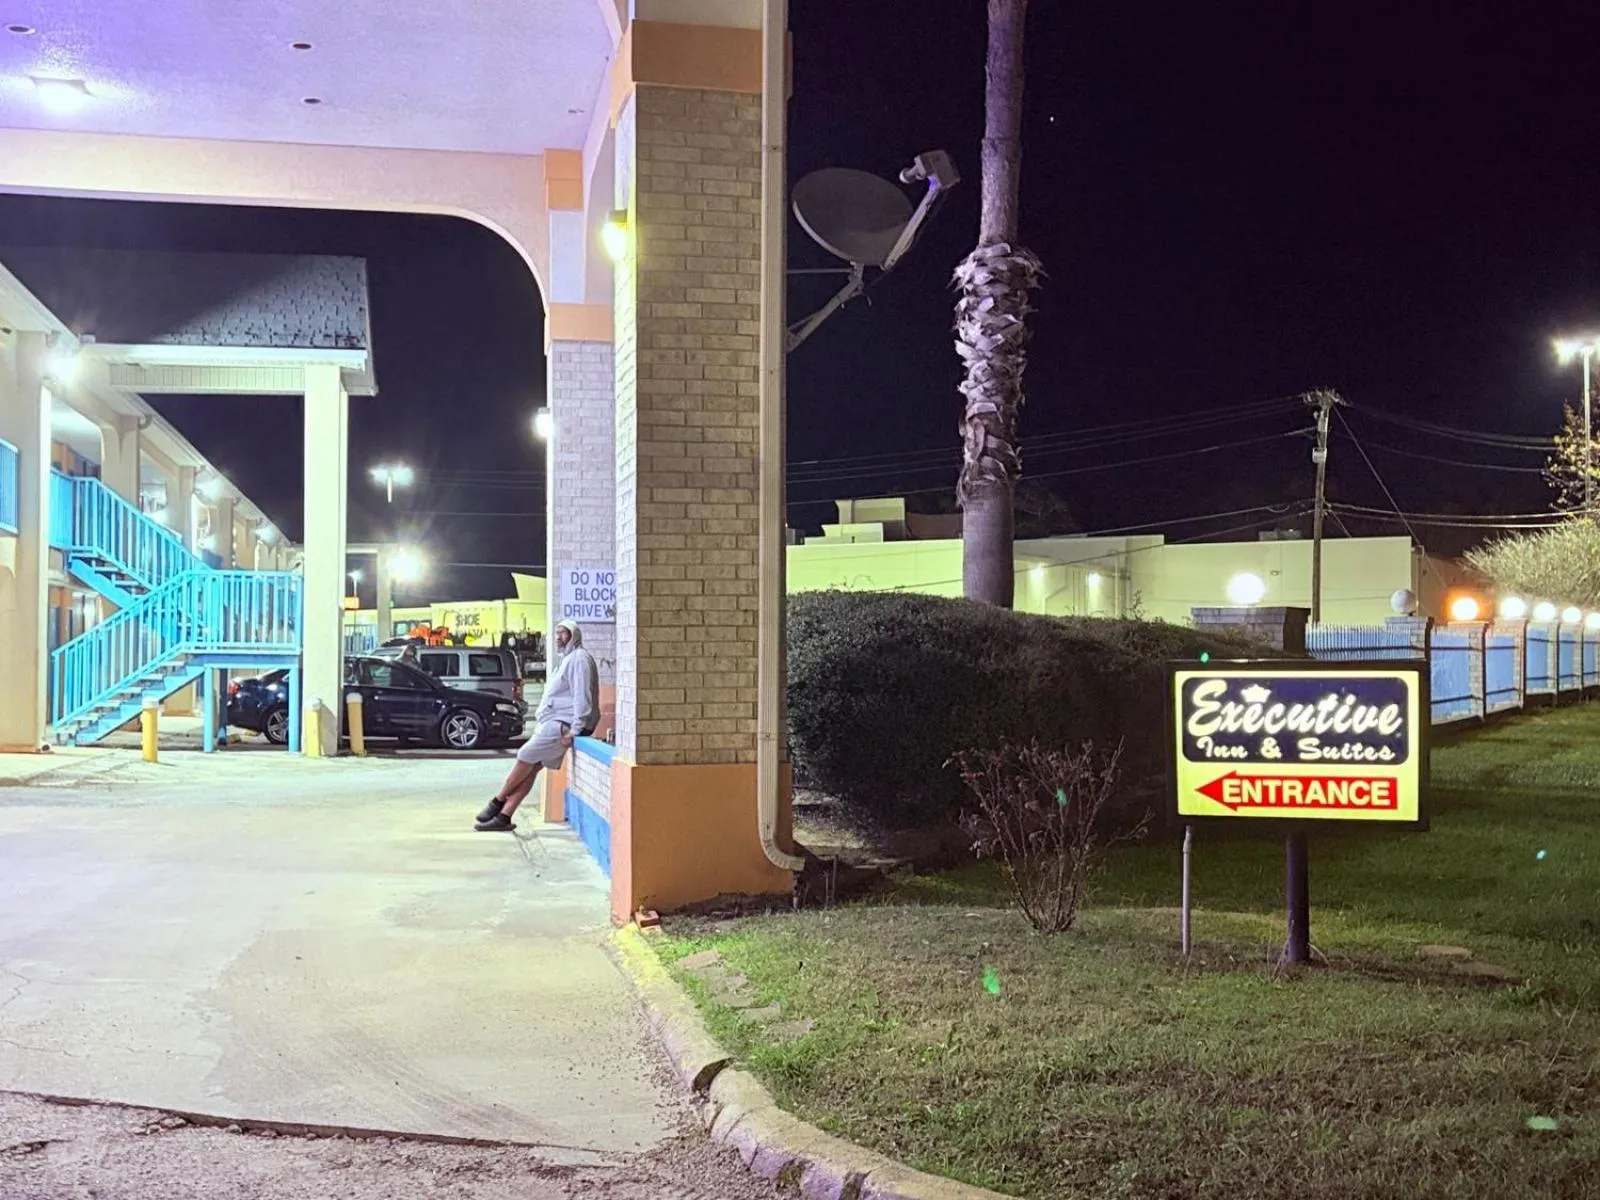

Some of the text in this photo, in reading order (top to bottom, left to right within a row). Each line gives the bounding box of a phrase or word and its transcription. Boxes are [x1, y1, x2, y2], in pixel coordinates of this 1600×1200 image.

[570, 571, 615, 586] DO NO
[574, 587, 616, 601] BLOCK
[1188, 679, 1403, 737] Executive
[1196, 736, 1396, 761] Inn & Suites
[1221, 778, 1392, 807] ENTRANCE
